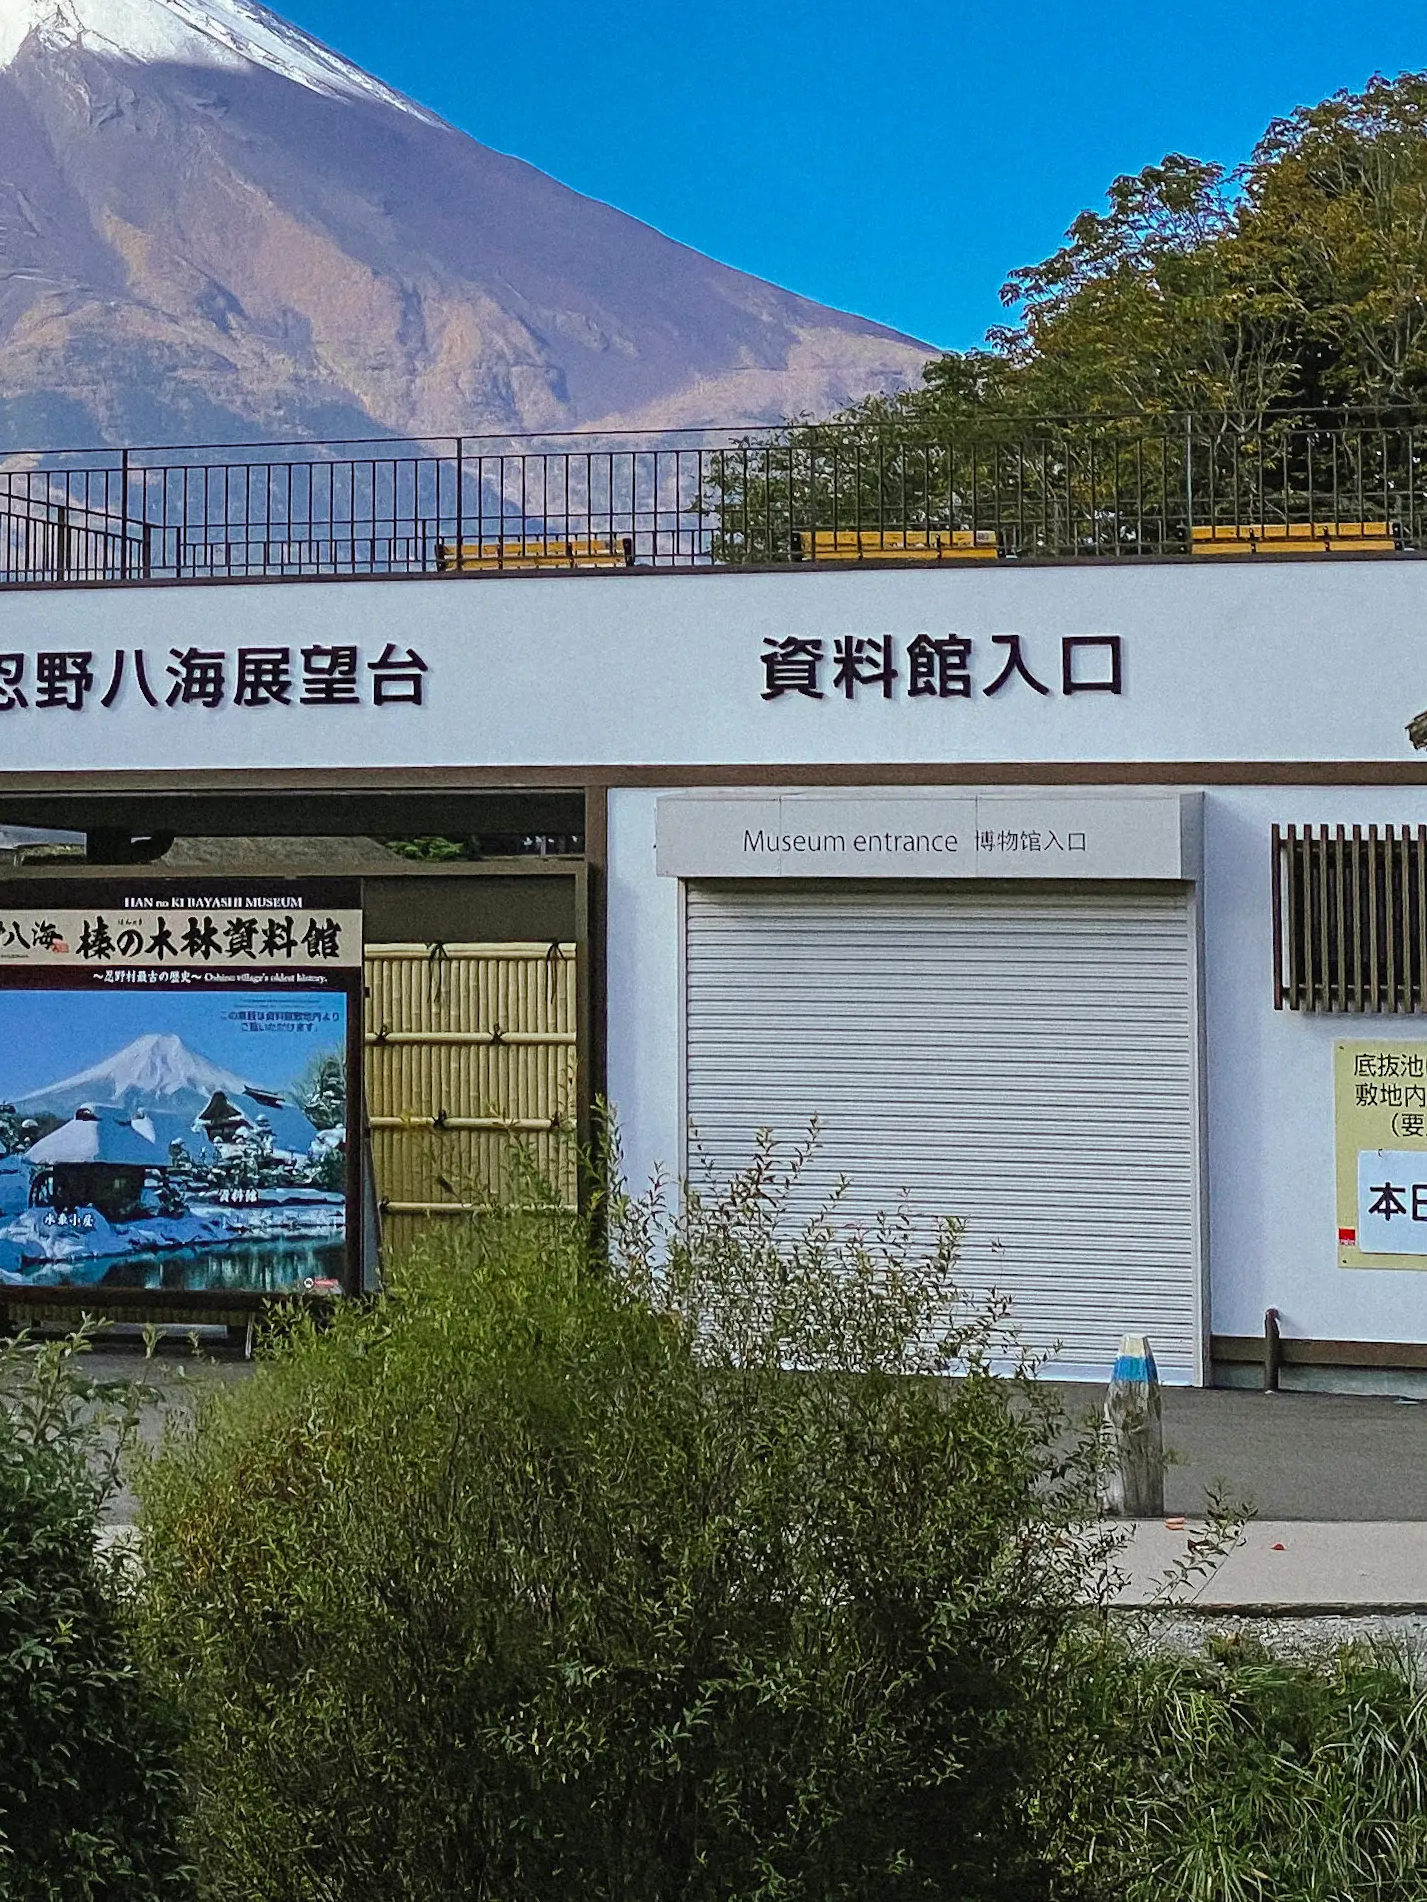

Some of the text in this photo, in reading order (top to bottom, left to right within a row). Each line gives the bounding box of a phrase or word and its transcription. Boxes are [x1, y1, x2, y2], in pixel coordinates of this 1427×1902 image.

[760, 633, 1122, 701] 資料館入口
[743, 829, 1086, 852] Museum entrance 博物馆入口
[124, 897, 153, 907] HAN
[245, 897, 302, 907] MUSEUM
[75, 915, 342, 960] 榛の木林資料館
[1353, 1052, 1427, 1078] 底抜池
[1355, 1082, 1426, 1108] 敷地内
[1391, 1112, 1427, 1138] （要
